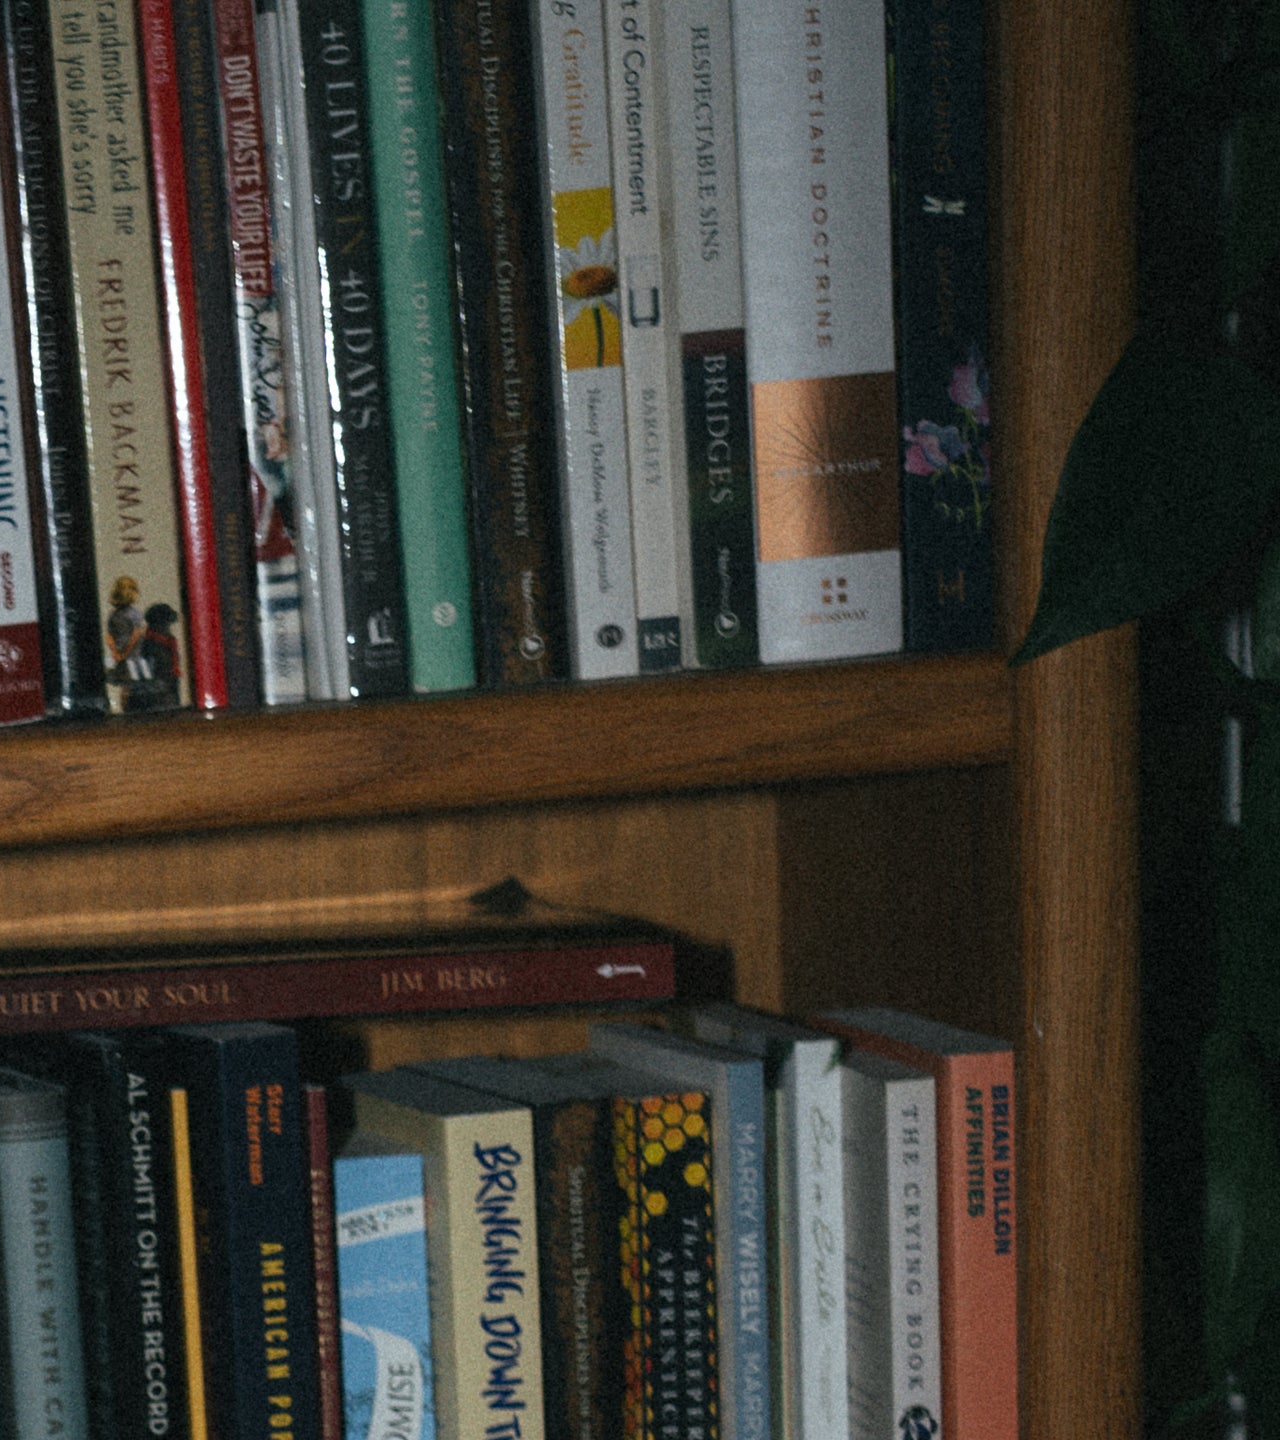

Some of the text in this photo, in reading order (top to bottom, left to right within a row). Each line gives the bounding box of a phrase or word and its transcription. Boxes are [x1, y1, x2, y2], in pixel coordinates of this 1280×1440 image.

[57, 10, 98, 215] tell you she's sorry
[558, 27, 593, 166] Gratitude
[619, 16, 652, 215] of Contentment
[689, 25, 721, 261] RESPECTABLE SINS
[221, 54, 270, 293] DON'T WASTE YOUR LIFE
[94, 257, 148, 556] FREDRIK BACKMAN
[702, 354, 733, 504] BRIDGES
[73, 986, 149, 1012] YOUR
[163, 980, 237, 1007] SOUL
[380, 965, 507, 997] JIM BERG
[243, 1084, 270, 1185] Waterman
[264, 1083, 286, 1134] Starr
[965, 1086, 985, 1216] AFFINITIES
[991, 1086, 1012, 1255] BRIAN DILLON
[124, 1071, 170, 1435] AL SCHMITT ON THE RECORD
[471, 1140, 525, 1303] BRINGING
[258, 1240, 290, 1380] AMERICAN
[477, 1313, 525, 1409] DOWN
